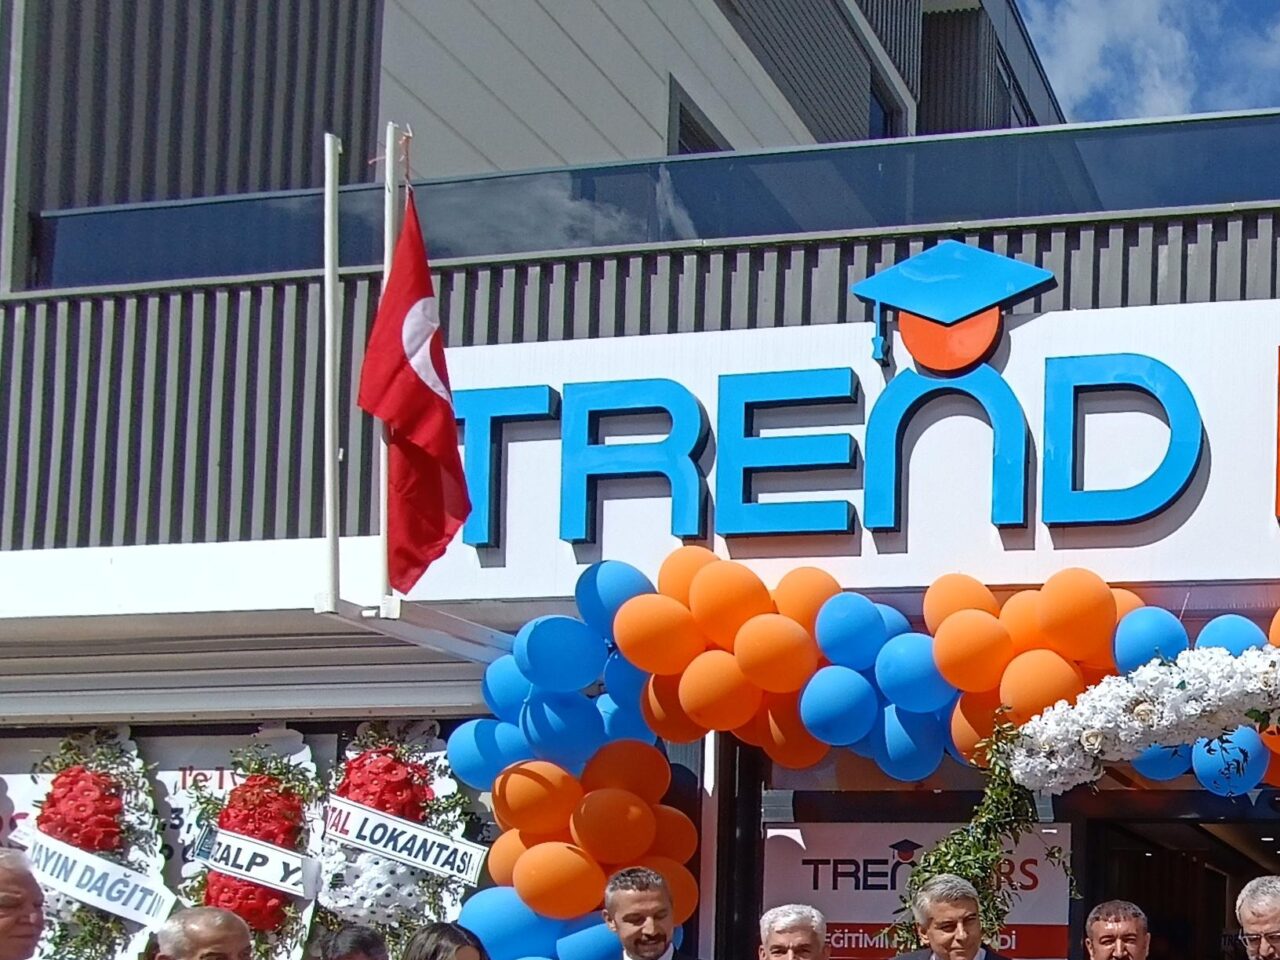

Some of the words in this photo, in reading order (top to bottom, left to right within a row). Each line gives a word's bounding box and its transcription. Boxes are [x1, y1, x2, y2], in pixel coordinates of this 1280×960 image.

[451, 353, 1203, 549] TREND
[355, 817, 473, 876] LOKANTASI
[802, 858, 1039, 891] TRENRS
